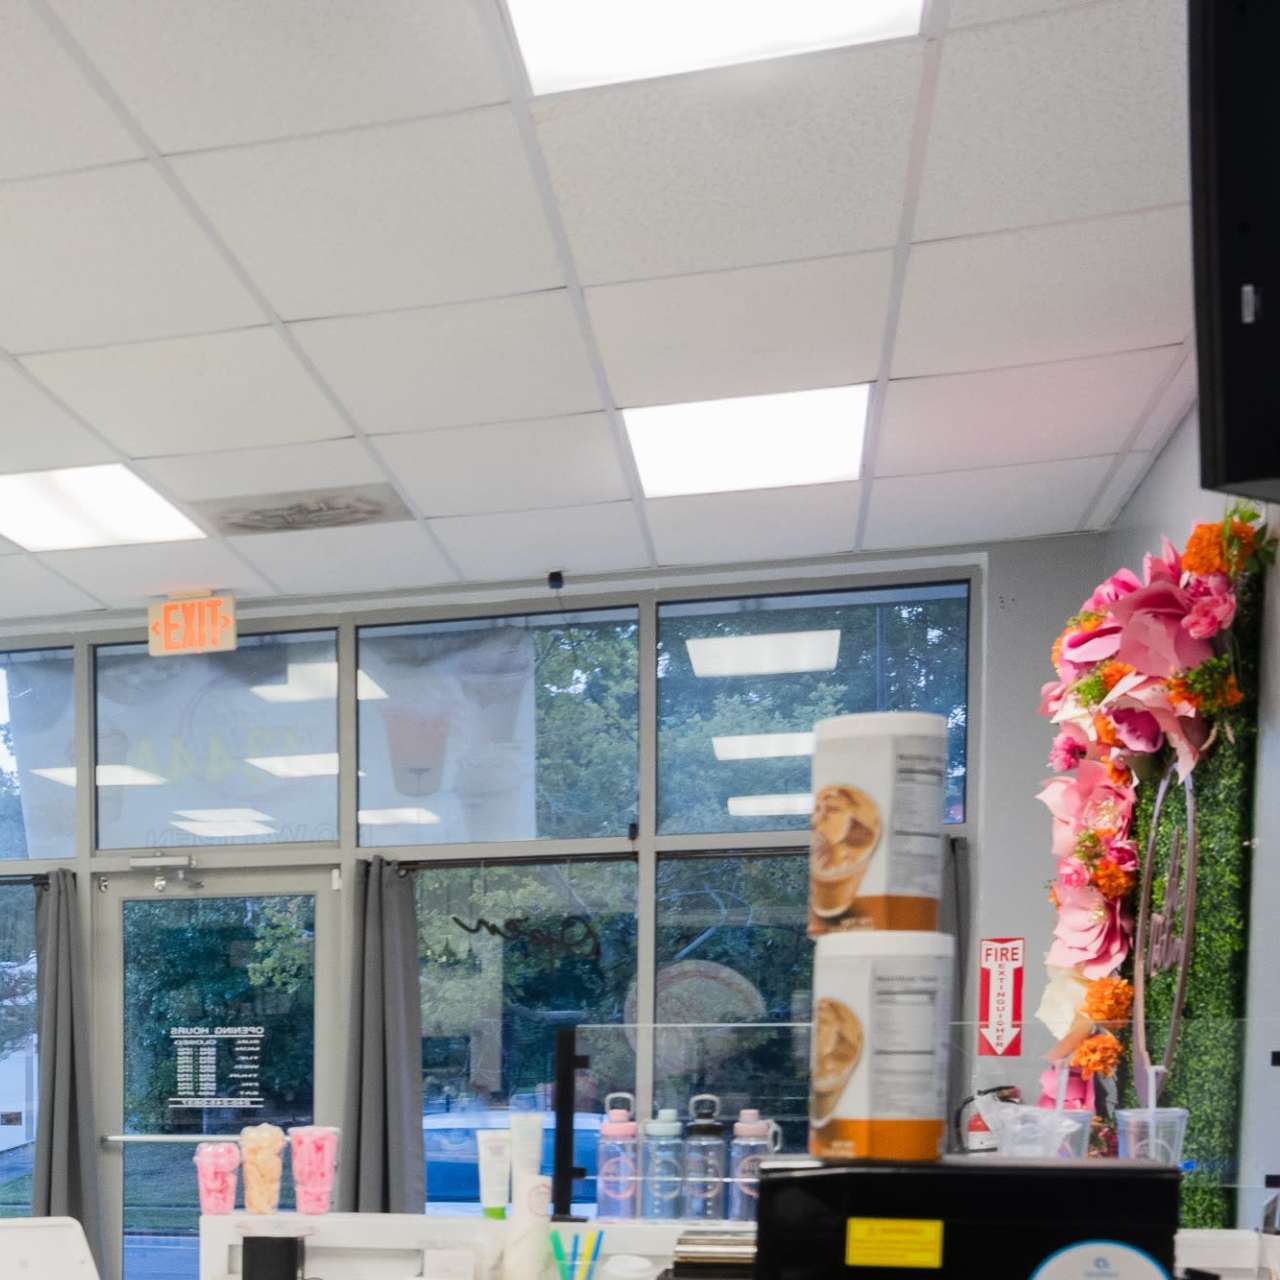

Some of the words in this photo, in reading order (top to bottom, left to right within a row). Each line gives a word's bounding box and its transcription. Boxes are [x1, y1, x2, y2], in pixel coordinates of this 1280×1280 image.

[163, 599, 221, 652] EXIT
[985, 947, 1020, 962] FIRE
[995, 963, 1006, 1048] EXTINGUISHER
